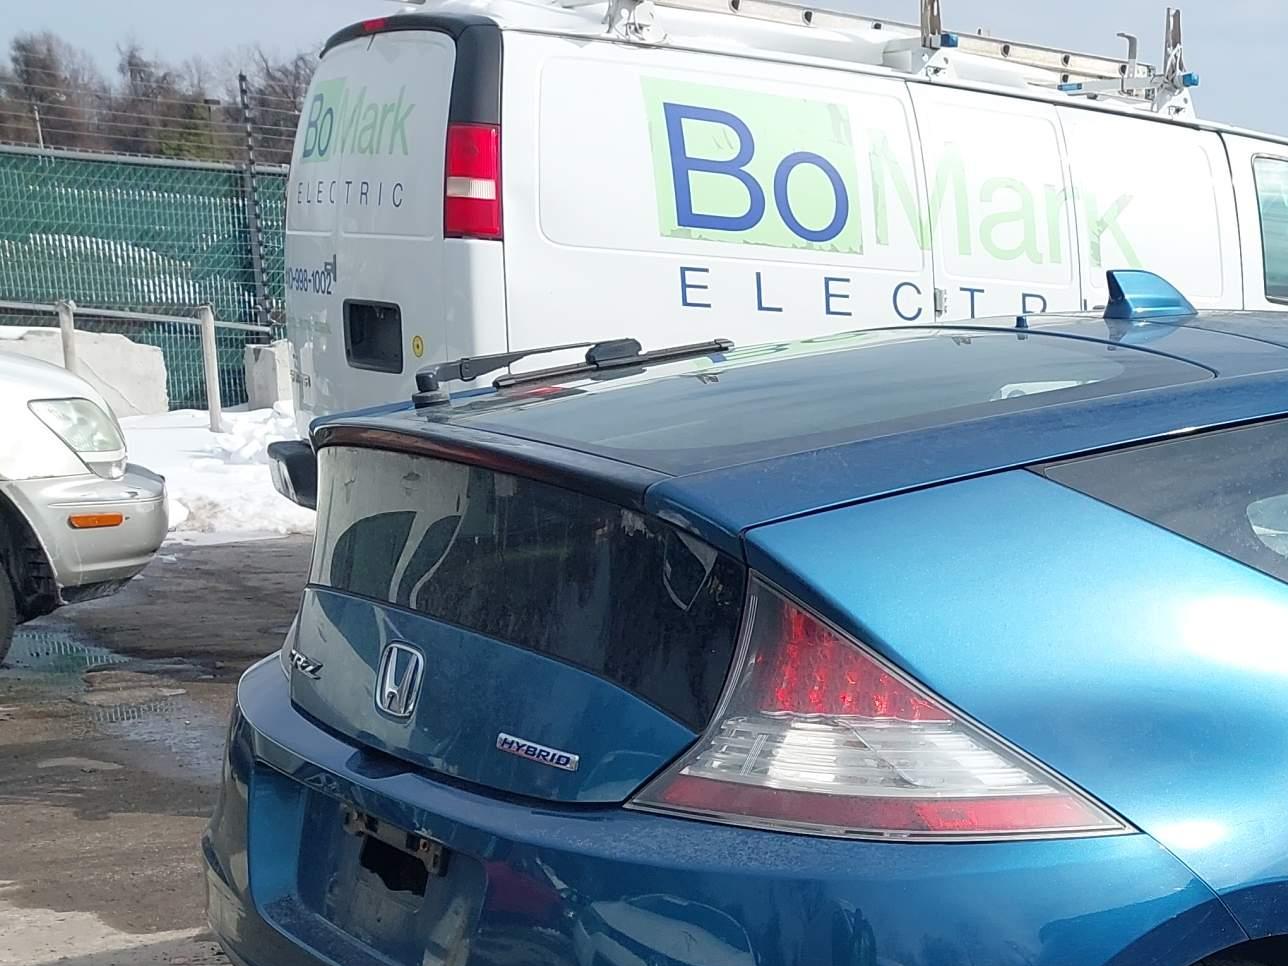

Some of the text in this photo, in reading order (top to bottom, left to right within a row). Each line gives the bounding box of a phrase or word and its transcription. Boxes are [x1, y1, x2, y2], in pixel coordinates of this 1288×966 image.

[297, 181, 404, 207] ELECTRIC
[285, 267, 332, 295] 0-998-1002
[501, 737, 571, 767] HYBRID
